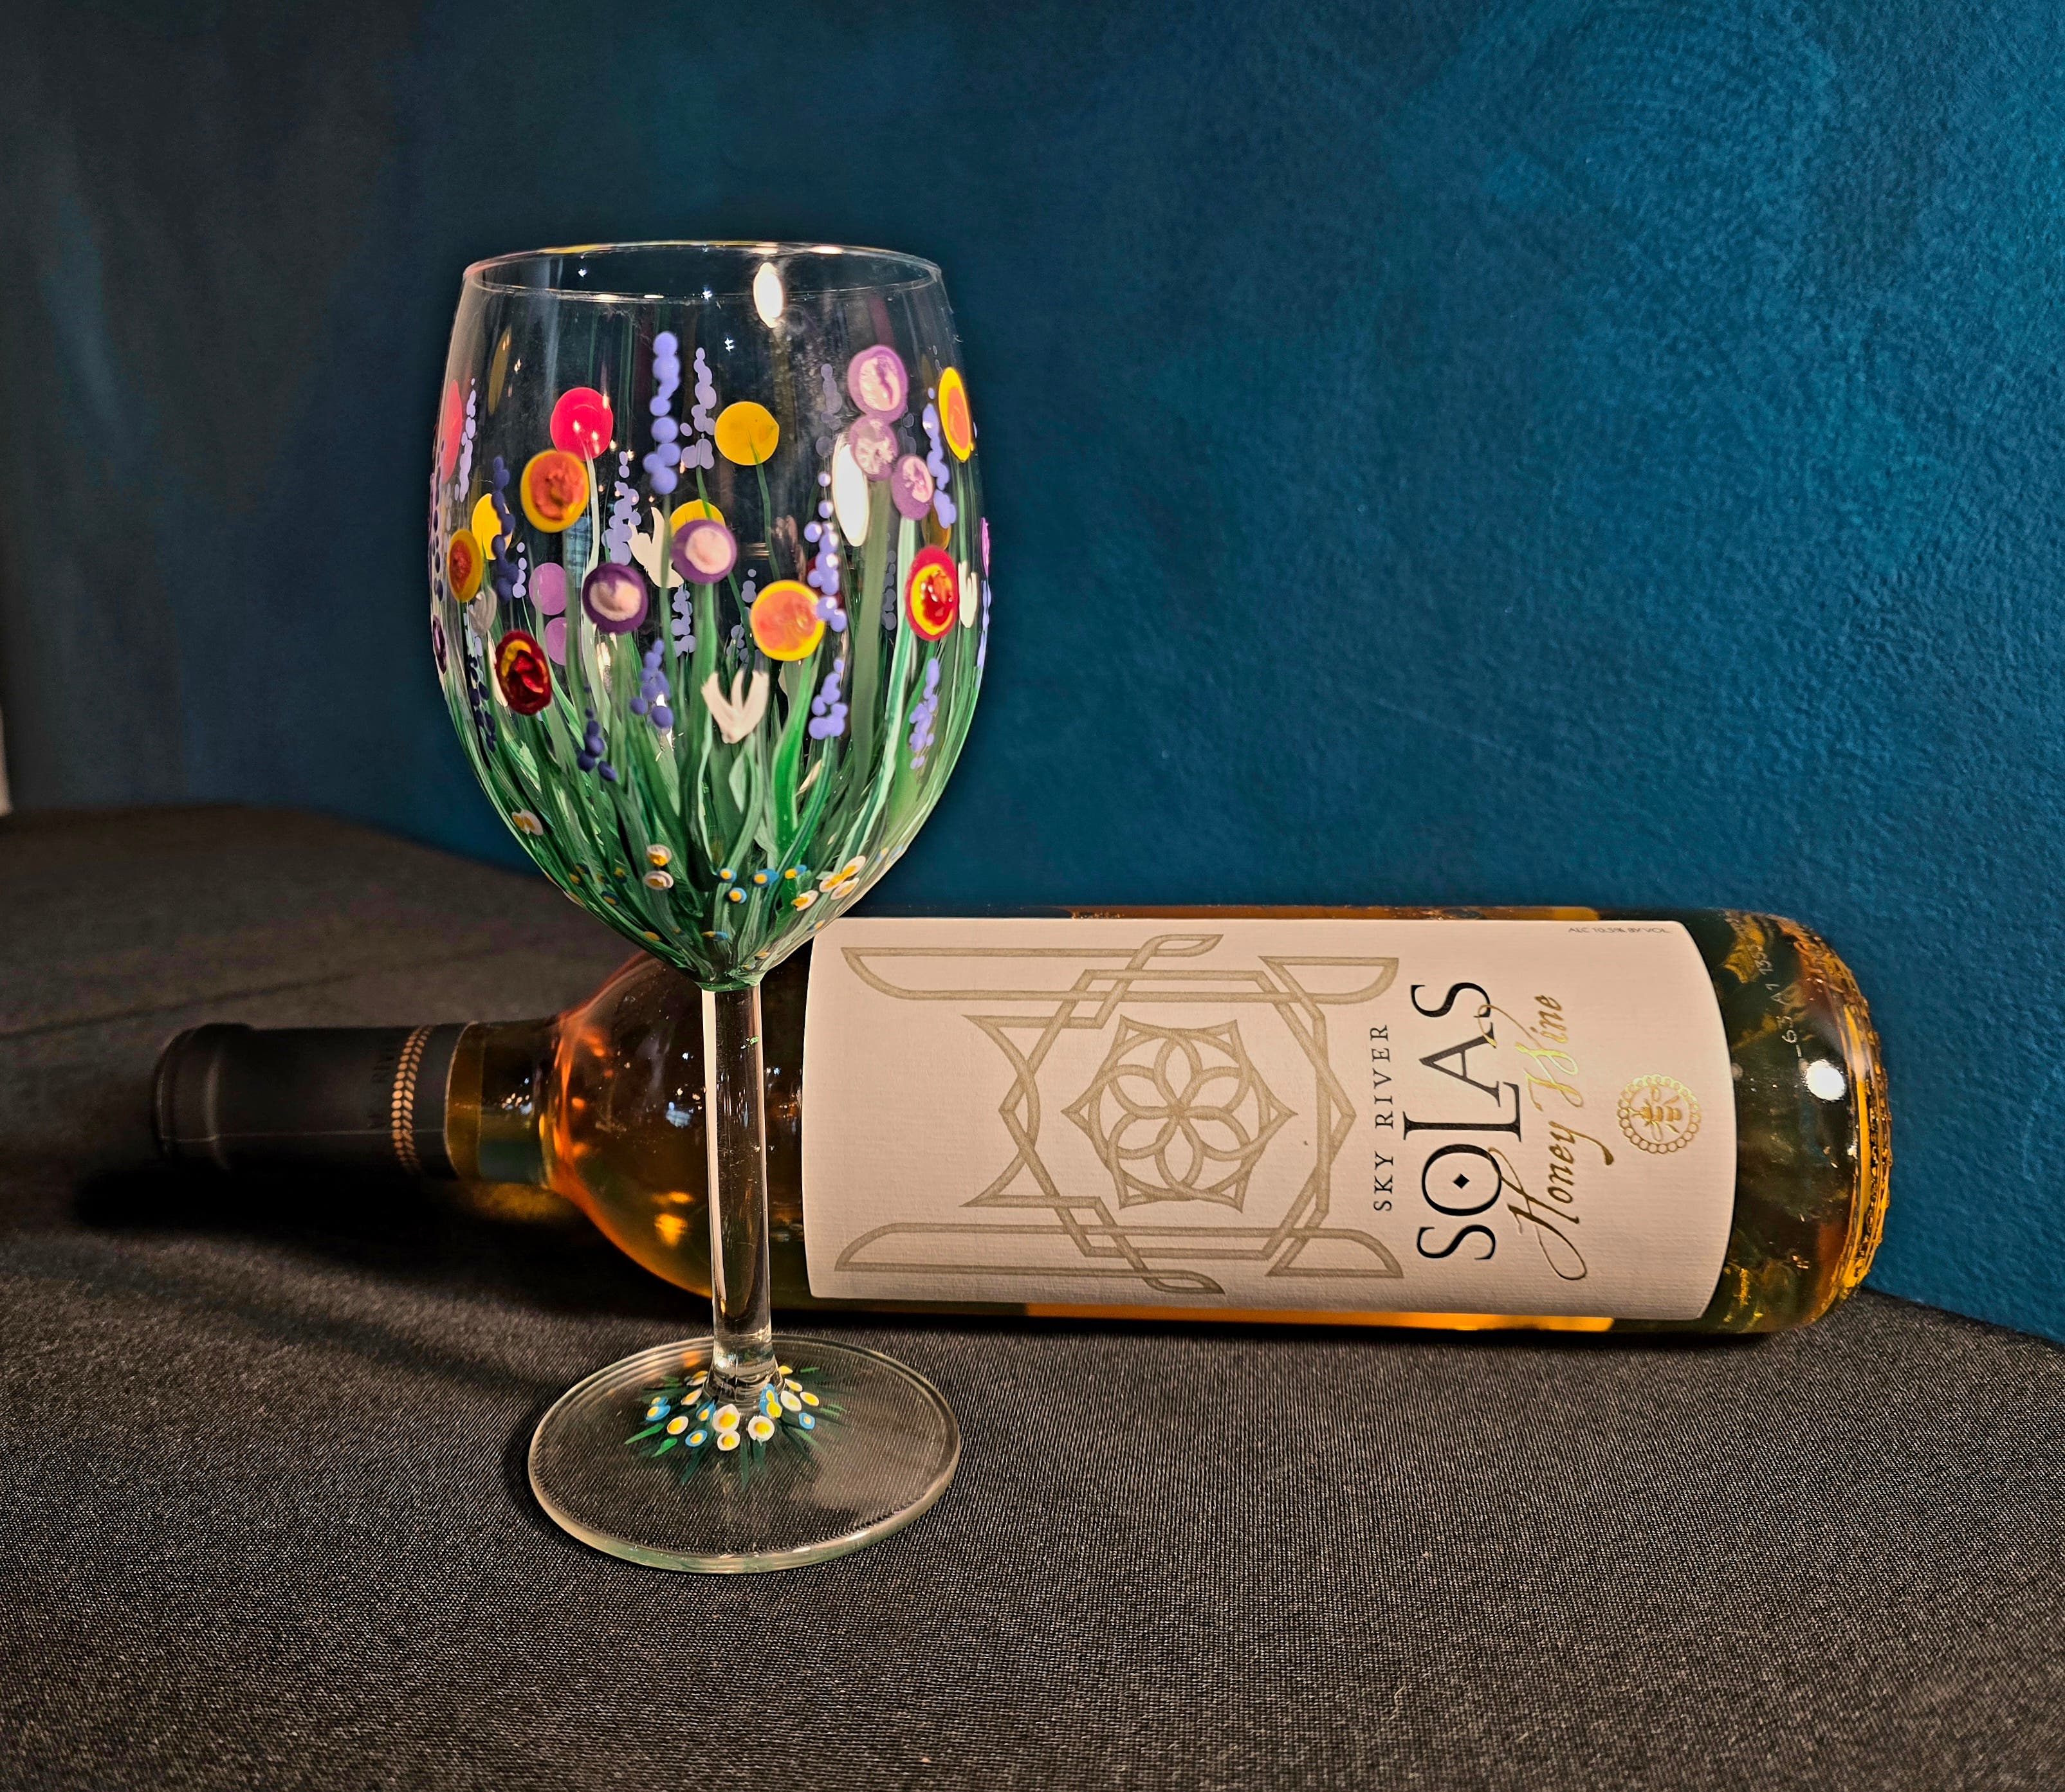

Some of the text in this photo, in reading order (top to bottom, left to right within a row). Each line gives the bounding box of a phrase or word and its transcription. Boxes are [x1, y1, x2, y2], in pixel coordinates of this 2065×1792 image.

[1370, 1025, 1393, 1211] SKY RIVER
[1402, 980, 1522, 1260] SOLAS
[1478, 994, 1614, 1281] Honey Wine
